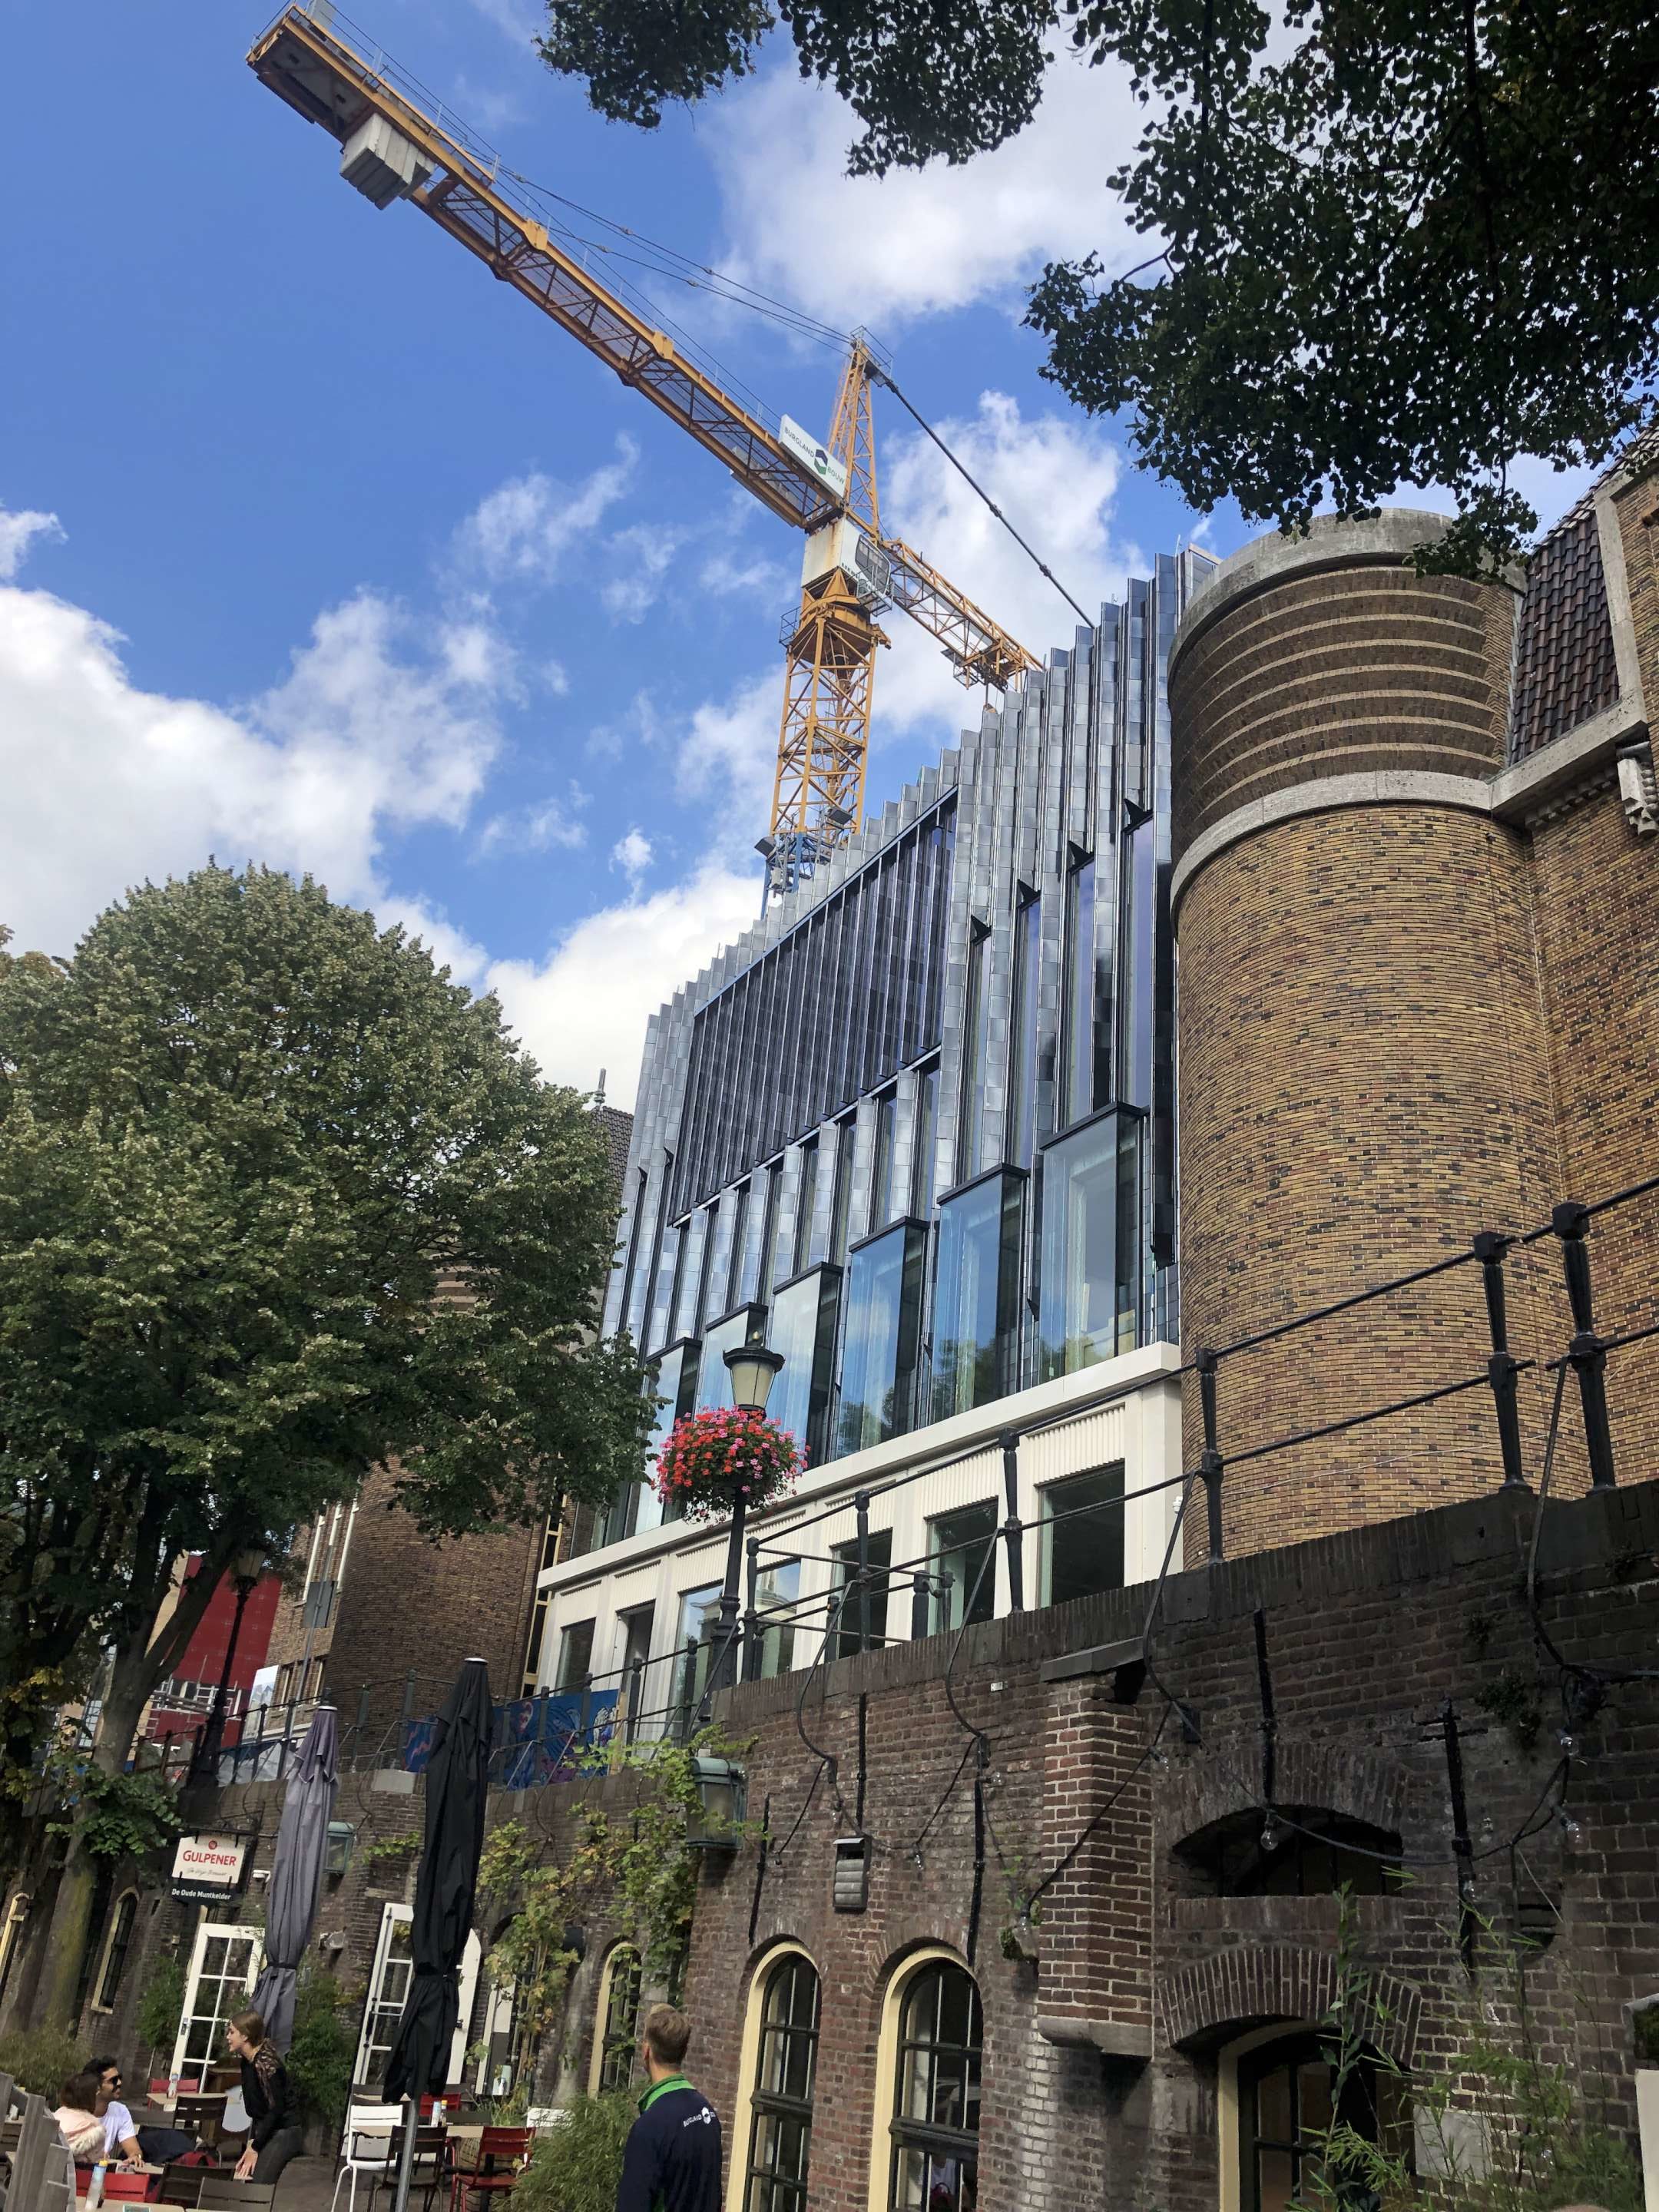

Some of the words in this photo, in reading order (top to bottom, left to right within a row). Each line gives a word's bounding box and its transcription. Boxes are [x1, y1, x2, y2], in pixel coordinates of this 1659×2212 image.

[784, 426, 815, 458] BURGLAND
[827, 466, 845, 485] BOUW
[183, 1850, 237, 1866] GULPENER
[197, 1891, 231, 1900] Muntkelder
